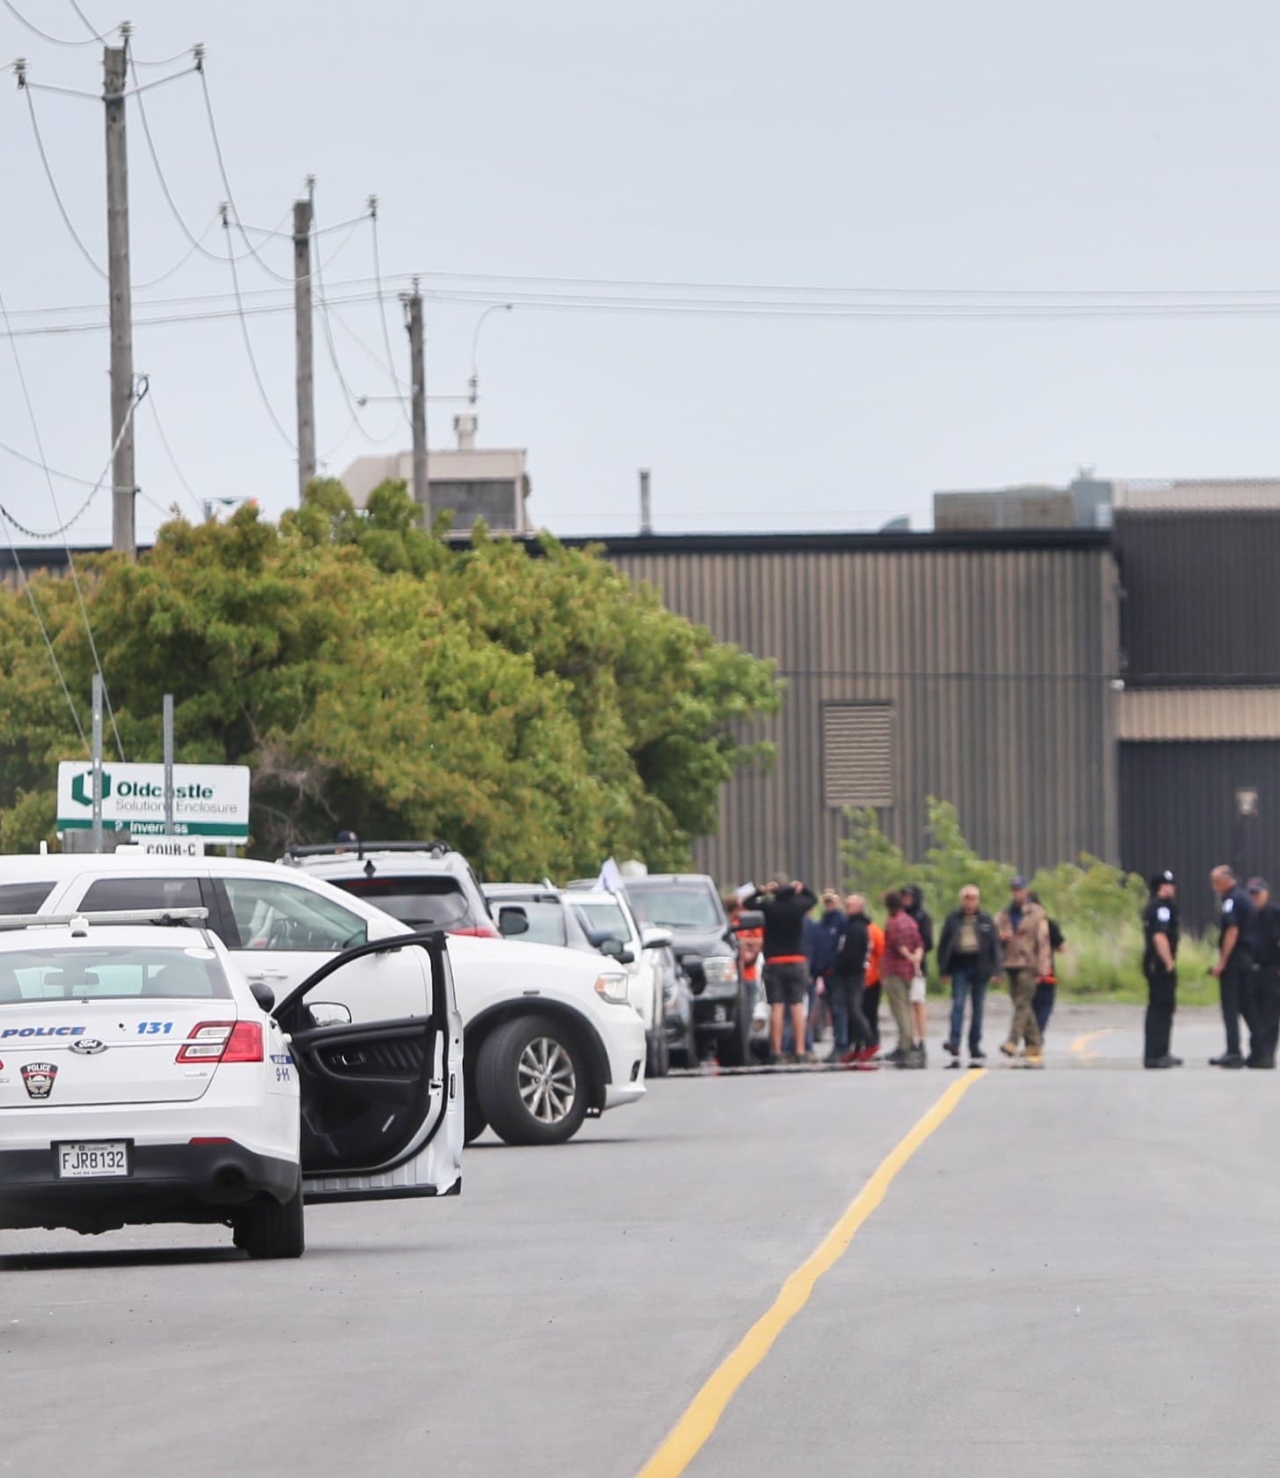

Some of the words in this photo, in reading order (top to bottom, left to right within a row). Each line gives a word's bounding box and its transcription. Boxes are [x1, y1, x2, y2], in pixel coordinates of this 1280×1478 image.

[117, 781, 213, 799] Oldcstle
[116, 799, 171, 812] Solution
[176, 801, 238, 814] Enclosure
[1, 1027, 86, 1038] POLICE
[137, 1022, 173, 1034] 131
[26, 1063, 52, 1072] POLICE
[62, 1151, 124, 1170] FJR8132
